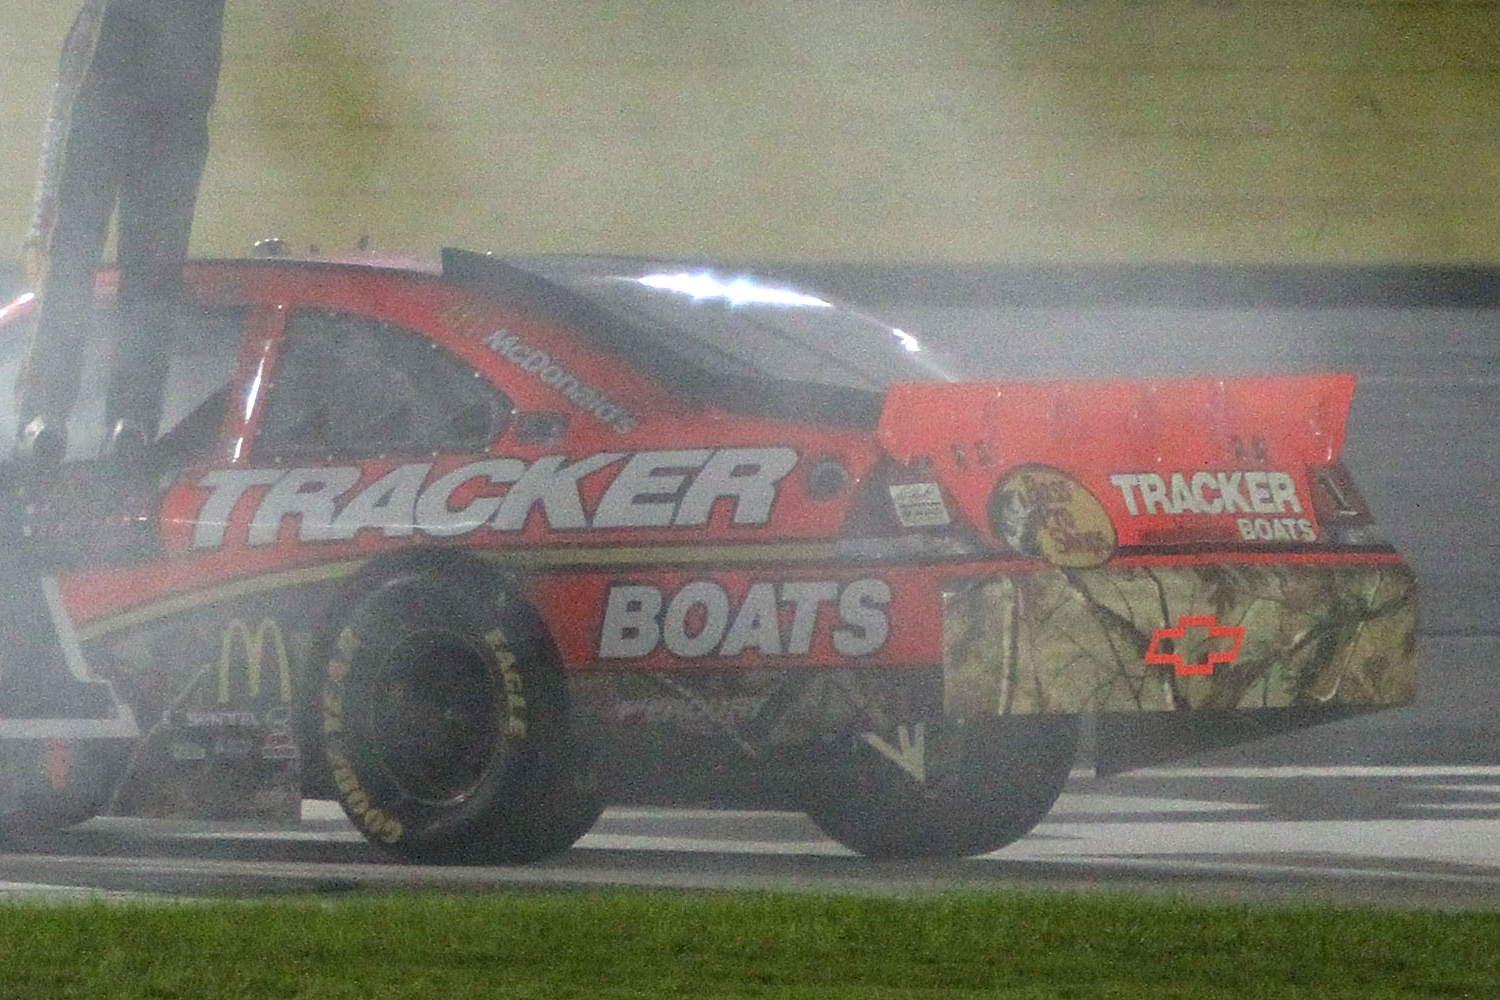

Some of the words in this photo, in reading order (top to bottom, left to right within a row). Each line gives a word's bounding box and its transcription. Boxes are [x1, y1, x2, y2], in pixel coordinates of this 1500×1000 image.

[192, 446, 799, 550] TRACKER
[1110, 471, 1303, 515] TRACKER
[1236, 517, 1316, 543] BOATS
[599, 577, 893, 660] BOATS
